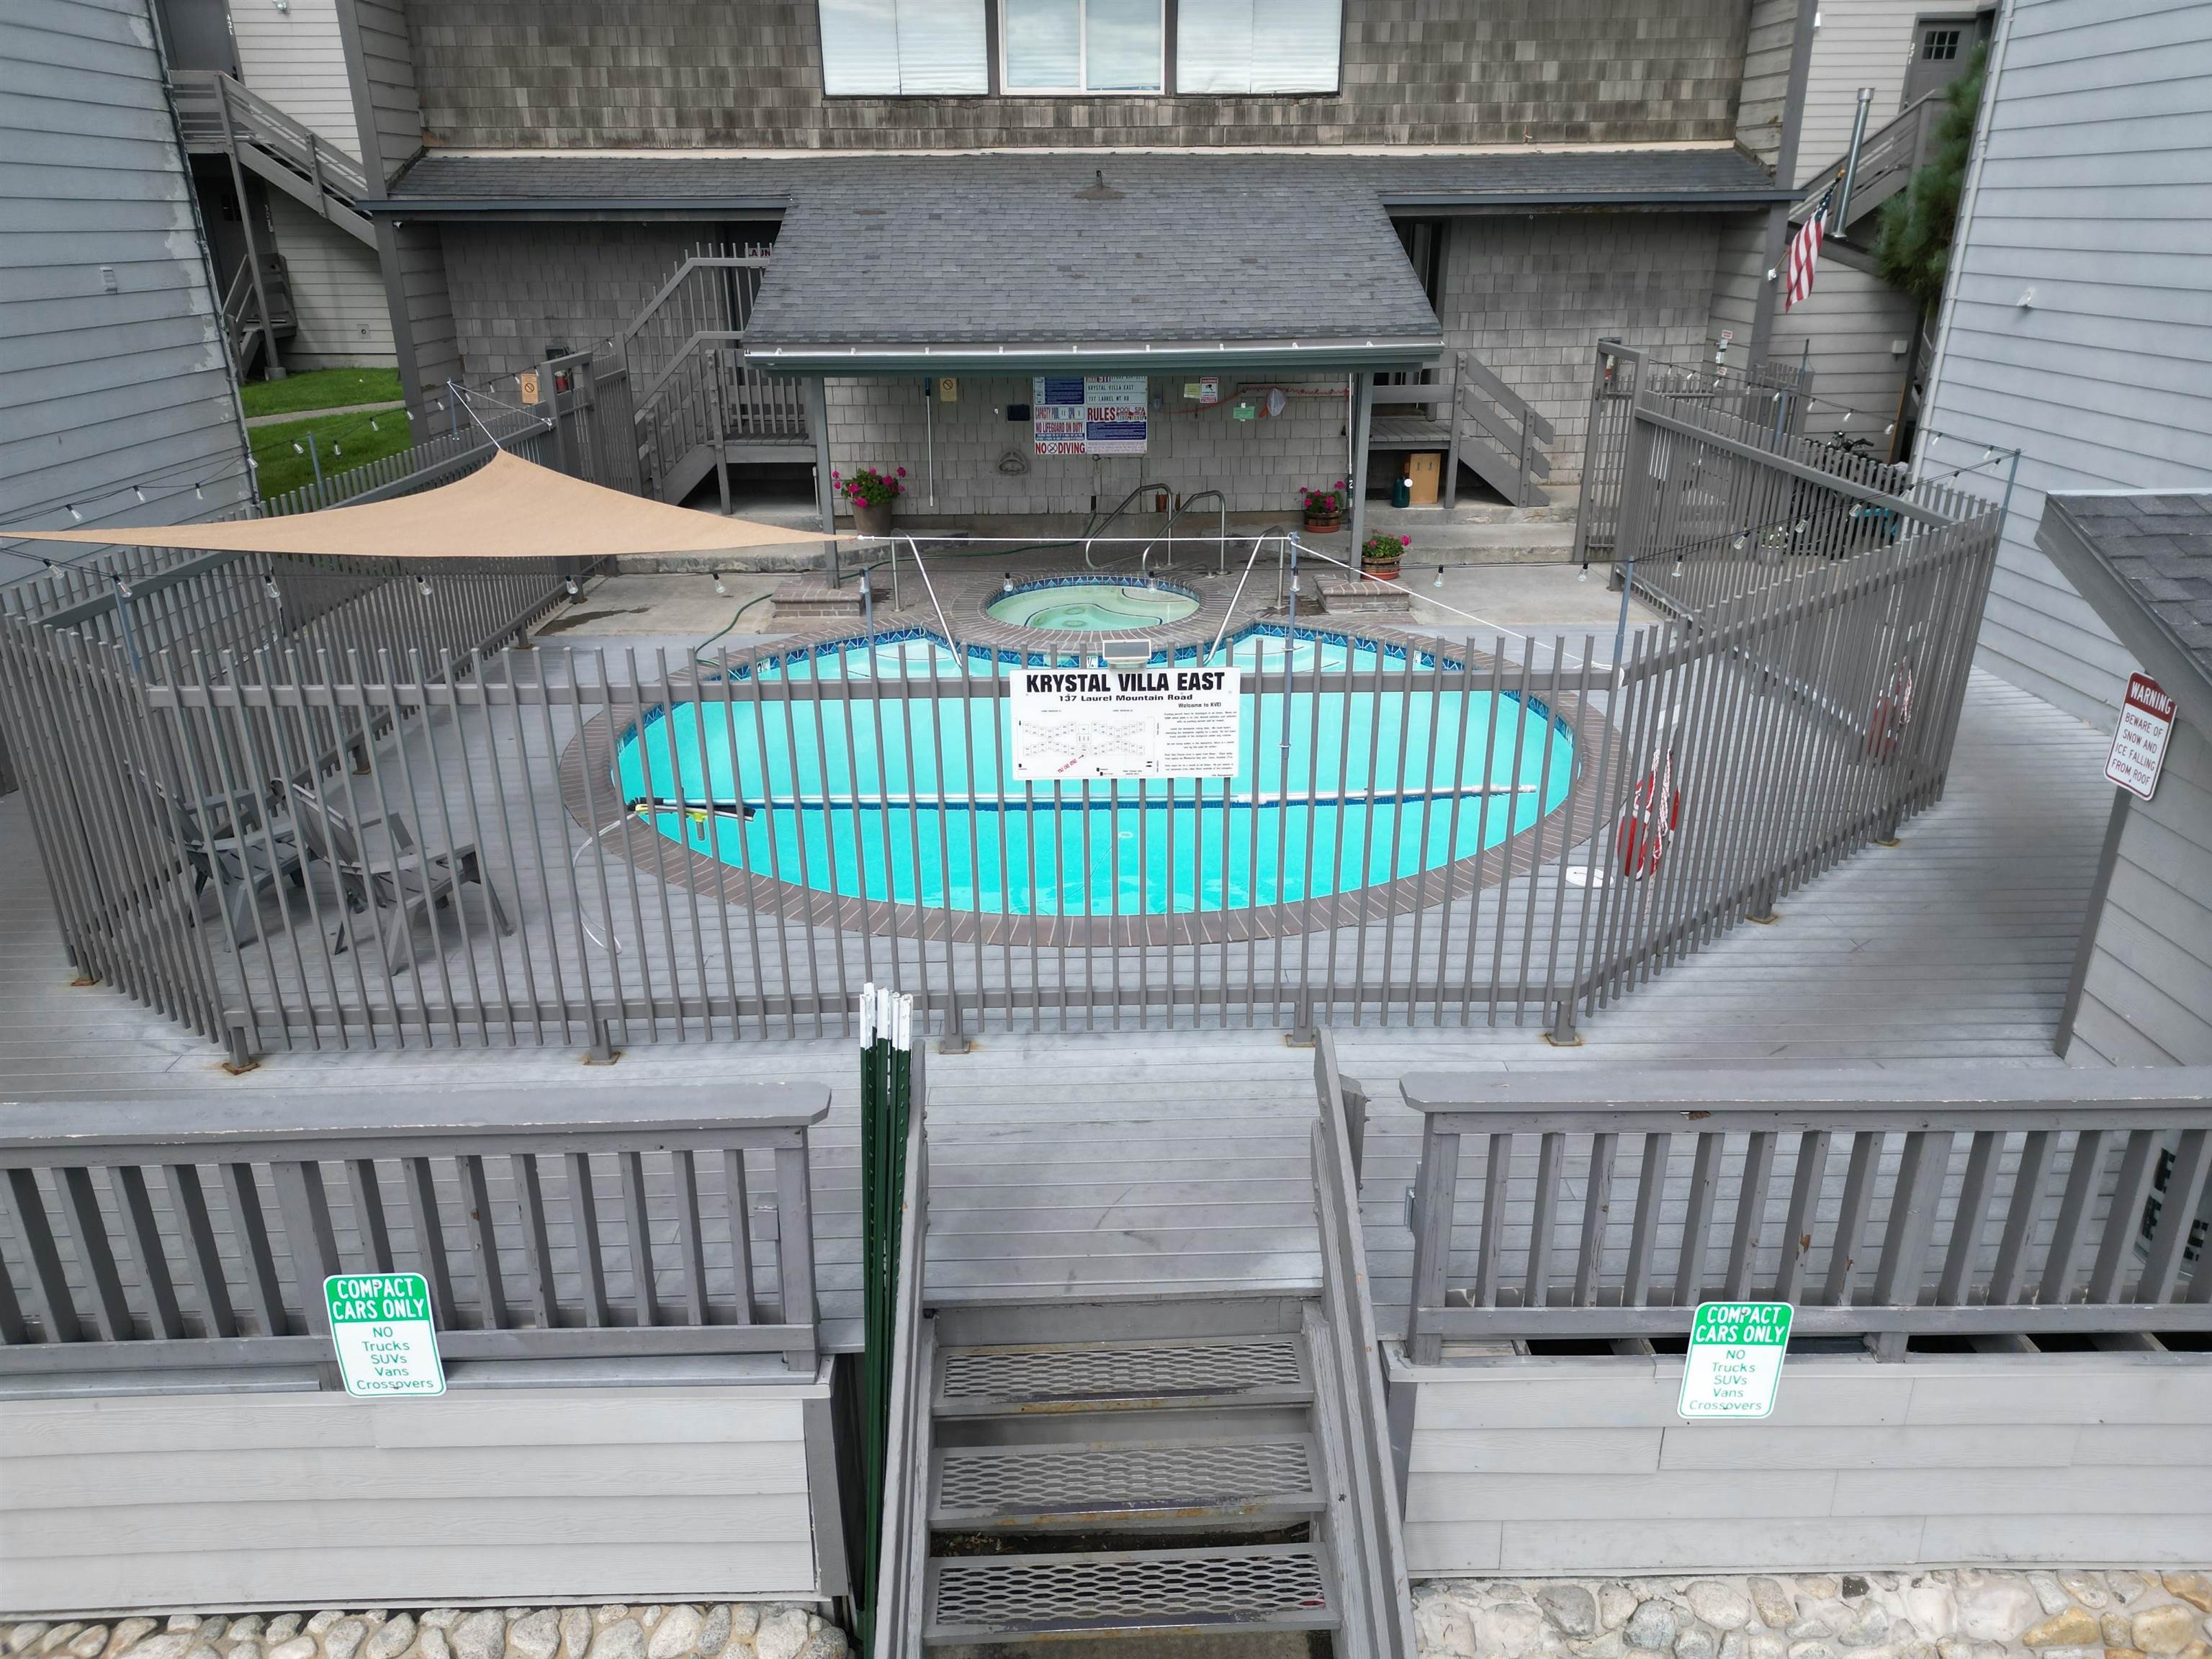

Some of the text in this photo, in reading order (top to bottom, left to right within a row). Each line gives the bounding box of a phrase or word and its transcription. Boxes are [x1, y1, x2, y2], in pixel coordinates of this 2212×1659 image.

[1087, 407, 1115, 421] RULES
[1036, 421, 1042, 433] NO
[1043, 421, 1065, 433] LIFEGUARD
[1066, 421, 1072, 433] ON
[1072, 421, 1083, 433] DUTY
[1035, 442, 1047, 454] NO
[1058, 442, 1085, 454] DIVING
[1026, 672, 1226, 693] KRYSTAL VILLA EAST
[2130, 681, 2173, 715] WARNING
[2125, 712, 2164, 738] BEWARE OF
[2123, 729, 2157, 754] SNOW AND
[2115, 742, 2156, 771] ICE FALLING
[2111, 758, 2151, 786] FROM ROOF
[337, 1278, 413, 1299] COMPACT
[333, 1298, 424, 1320] CARS ONLY
[1707, 1306, 1781, 1324] COMPACT
[372, 1326, 393, 1337] NO
[1696, 1325, 1786, 1343] CARS ONLY
[362, 1341, 410, 1352] Trucks
[371, 1354, 407, 1364] SUVs
[1726, 1349, 1745, 1359] NO
[374, 1367, 409, 1376] Vans
[1712, 1362, 1755, 1372] Trucks
[356, 1380, 433, 1390] Crossovers
[1714, 1375, 1748, 1385] SUVs
[1713, 1388, 1744, 1398] Vans
[1689, 1400, 1762, 1411] Crossovers
